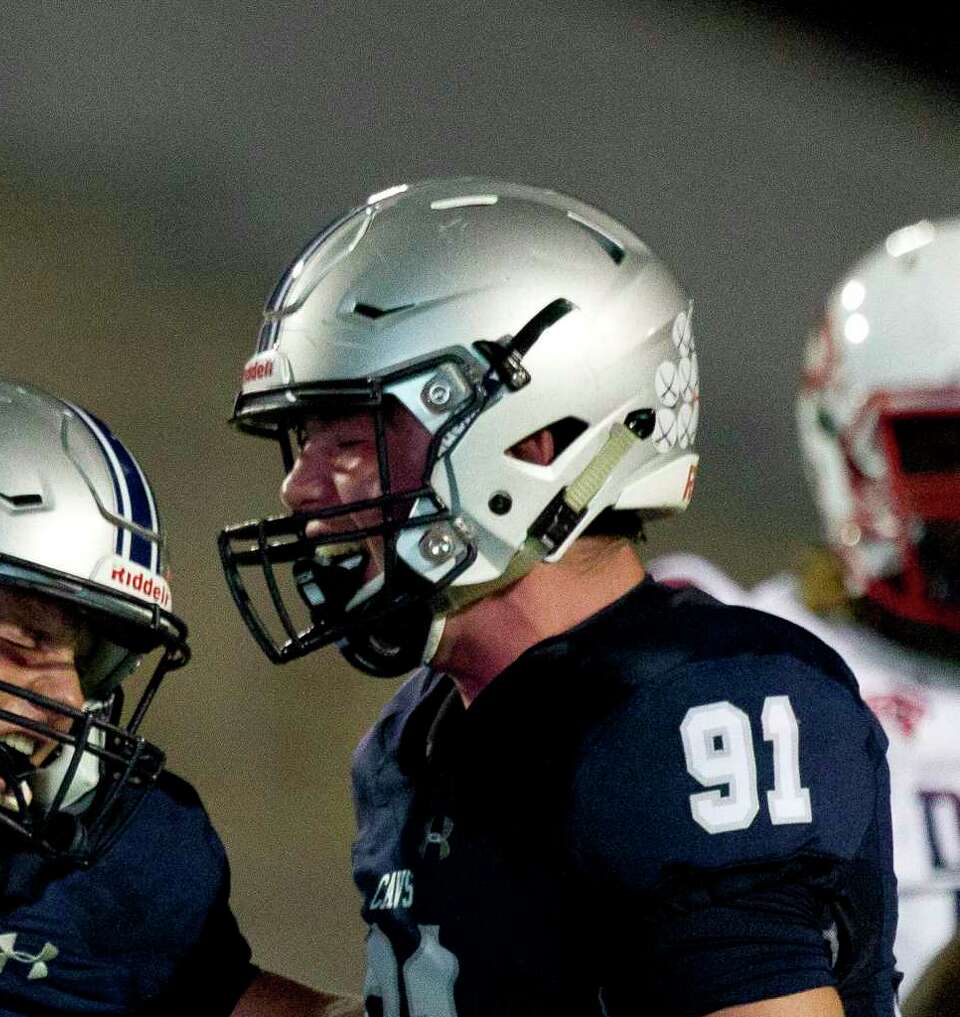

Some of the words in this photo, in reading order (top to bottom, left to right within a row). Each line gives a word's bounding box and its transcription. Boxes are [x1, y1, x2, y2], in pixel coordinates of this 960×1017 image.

[111, 567, 169, 607] Riddell
[680, 695, 813, 834] 91
[369, 869, 414, 910] CAVS
